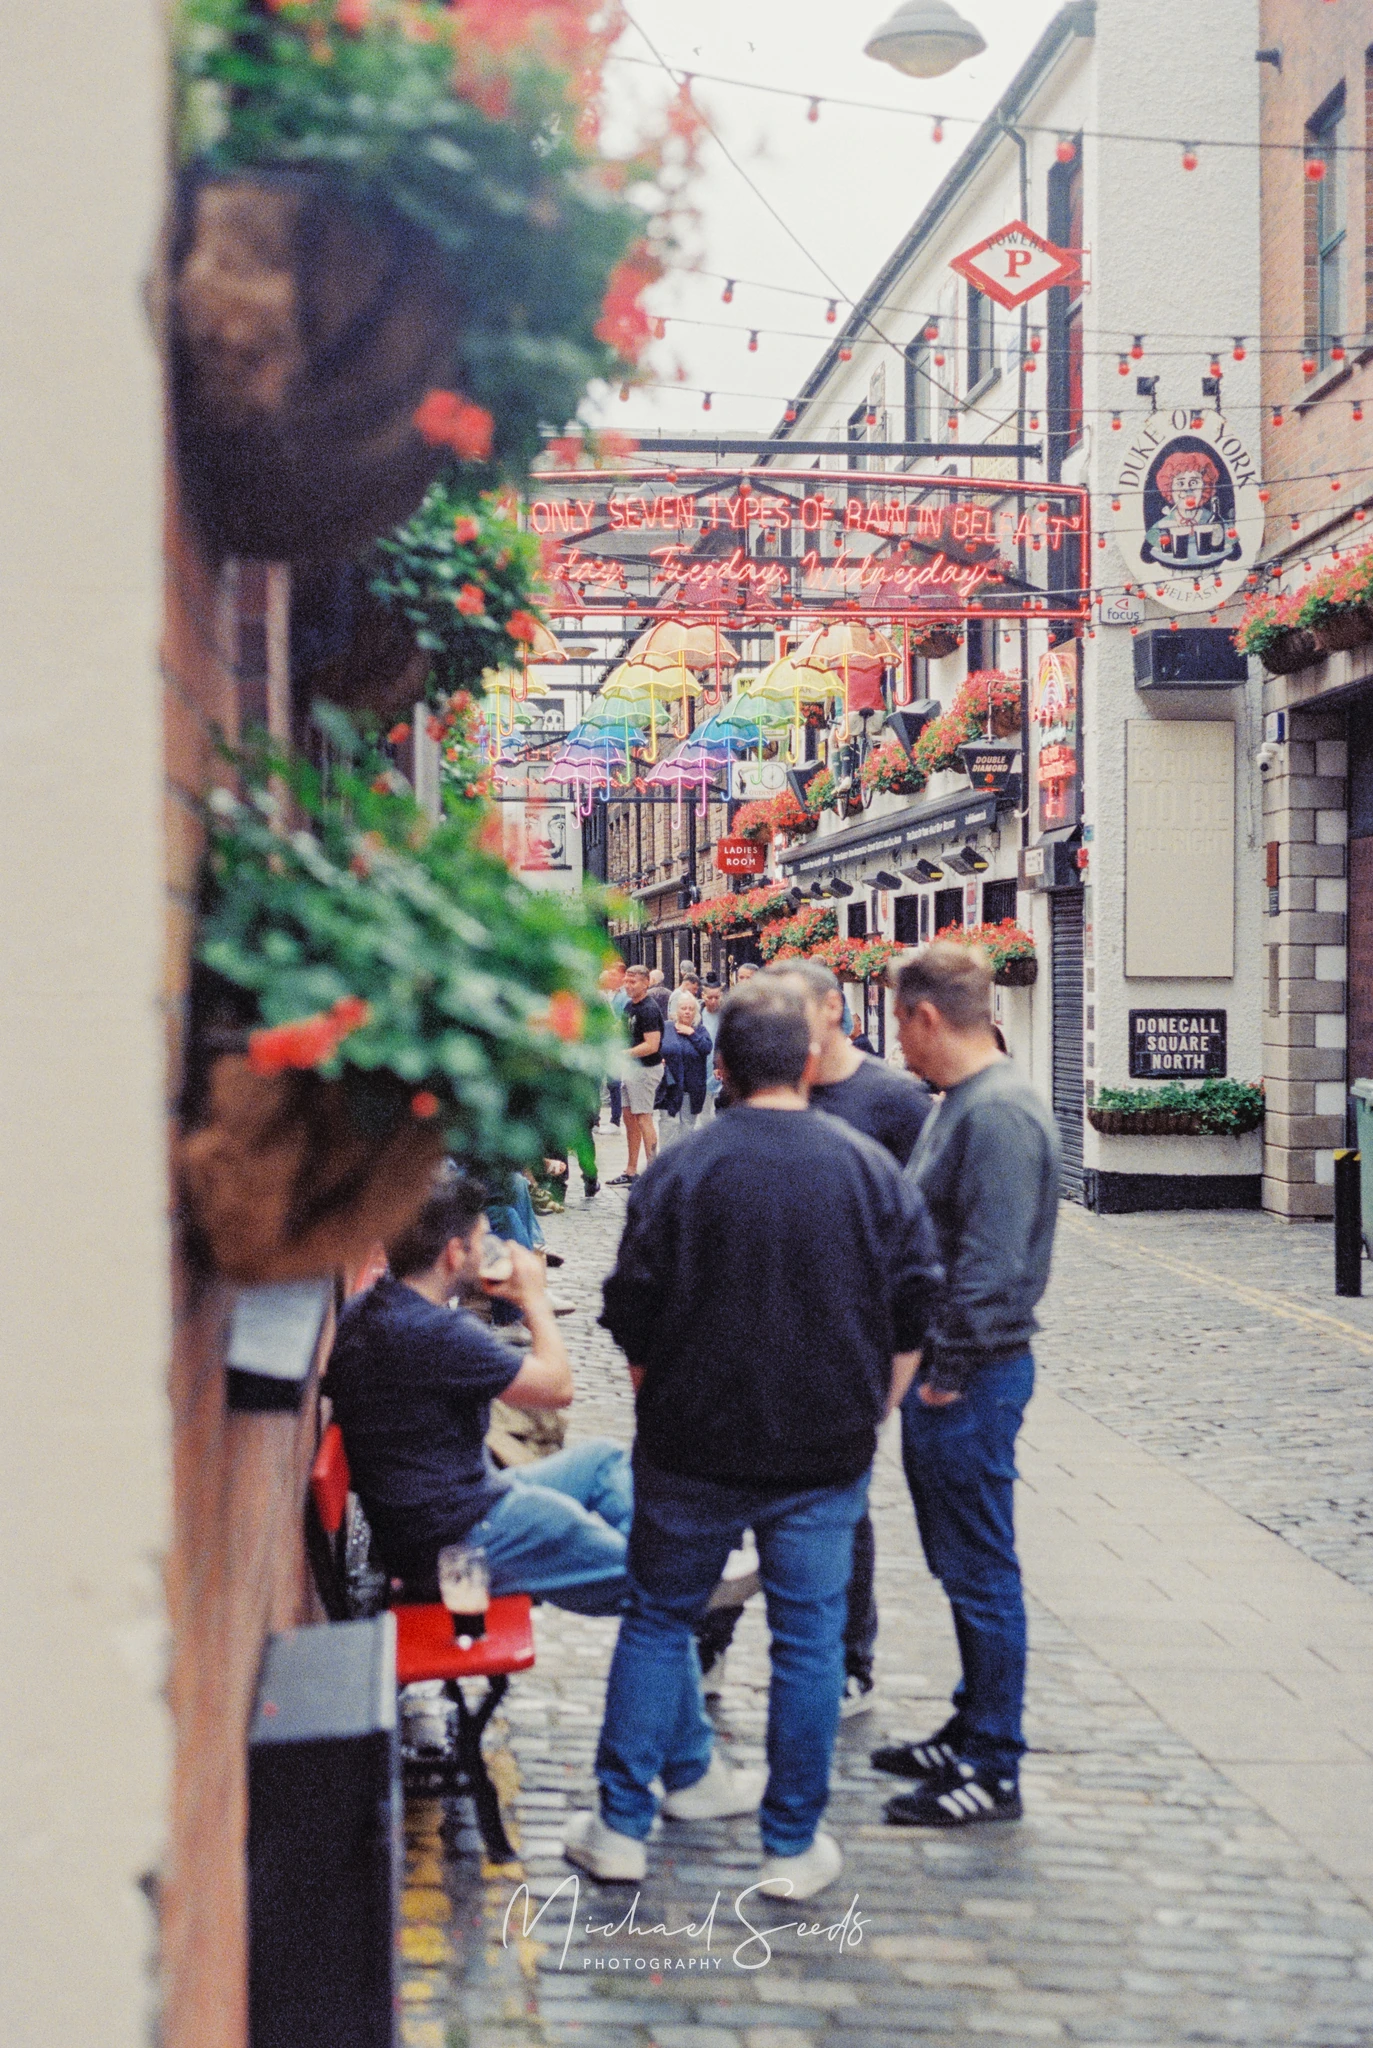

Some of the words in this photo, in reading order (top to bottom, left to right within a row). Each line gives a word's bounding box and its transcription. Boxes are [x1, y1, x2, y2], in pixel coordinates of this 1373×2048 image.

[986, 231, 1047, 254] POWERS
[1003, 249, 1032, 278] P
[1119, 428, 1166, 488] DUKE
[1171, 409, 1204, 431] OF
[1213, 423, 1257, 490] YORK
[530, 500, 595, 533] ONLY
[609, 497, 694, 530] SEVEN
[700, 497, 791, 529] TYPES
[801, 497, 835, 530] OF
[846, 499, 908, 534] RAIN
[916, 504, 943, 539] IN
[1163, 583, 1219, 602] BELFAST
[1107, 608, 1140, 621] focus
[975, 756, 1006, 764] DOUBLE
[972, 764, 1008, 773] DIAMOND
[1132, 780, 1177, 826] TO
[1189, 780, 1230, 826] BE
[724, 846, 758, 854] LADIES
[726, 858, 756, 866] ROOM
[1147, 1036, 1209, 1052] SQUARE
[1152, 1054, 1205, 1069] NORTH
